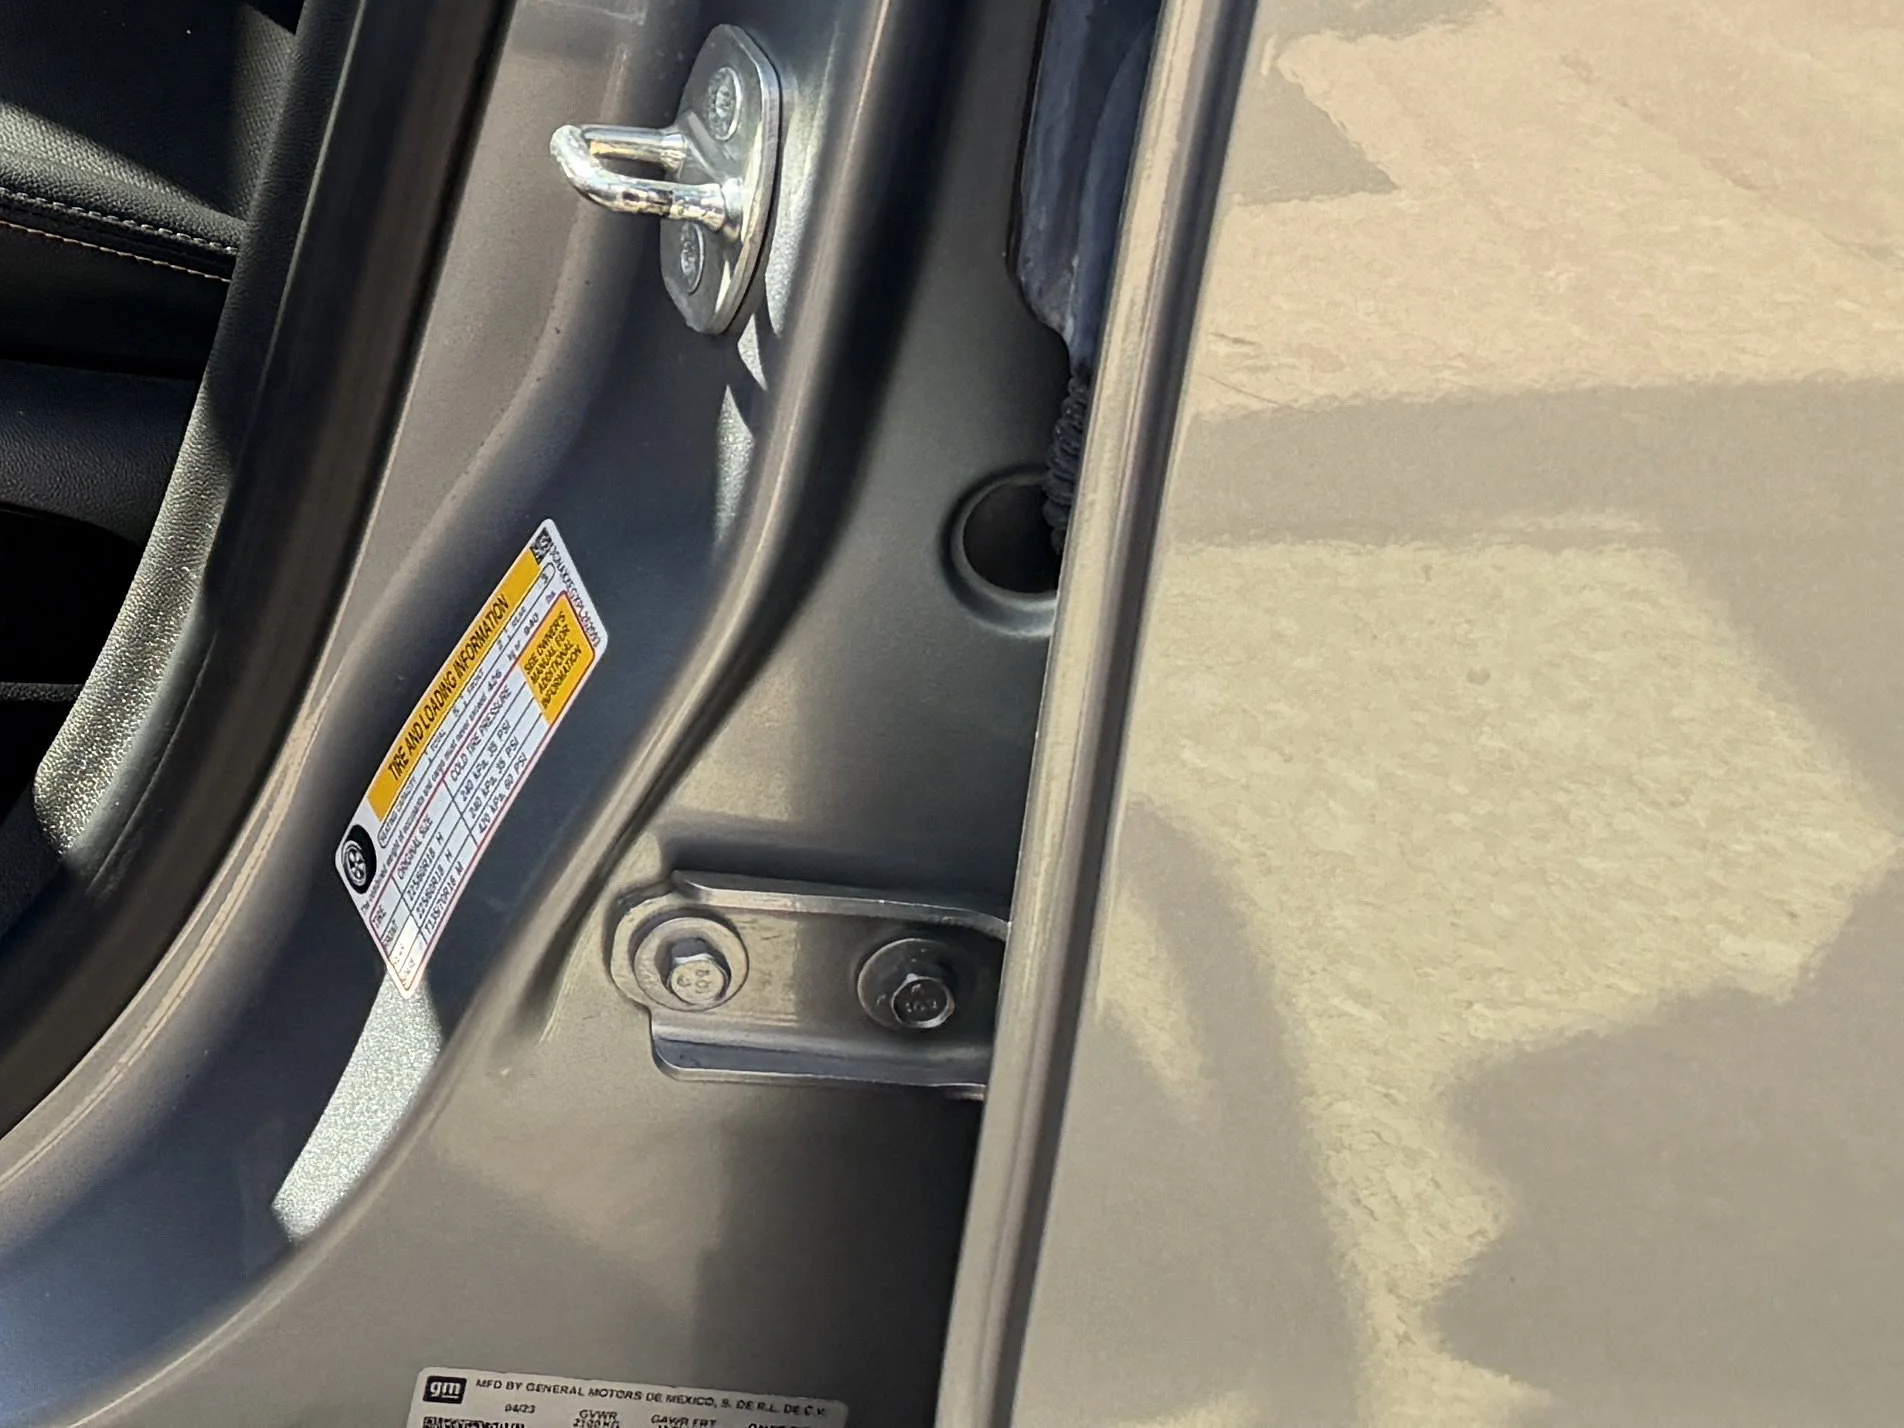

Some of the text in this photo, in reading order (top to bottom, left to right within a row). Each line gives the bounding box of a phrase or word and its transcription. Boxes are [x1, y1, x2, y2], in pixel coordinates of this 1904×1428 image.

[485, 665, 502, 694] 426
[522, 609, 539, 639] 940
[523, 649, 539, 676] SEE
[529, 620, 570, 687] MANUAL FOR
[537, 637, 573, 695] ADDITIONAL
[540, 642, 582, 710] INFORMATION
[387, 592, 509, 783] TIRE AND LOADING INFORMATION
[449, 683, 511, 783] COLD TIRE PRESSURE
[459, 777, 474, 802] 240
[496, 717, 511, 743] PSI
[504, 733, 519, 759] PSI
[513, 749, 527, 775] PSI
[396, 812, 433, 881] ORIGINAL SIZE
[372, 902, 386, 930] TIRE
[430, 1381, 460, 1399] gm
[476, 1379, 502, 1389] MFD
[505, 1381, 523, 1390] BY
[526, 1383, 585, 1396] GENERAL
[588, 1388, 642, 1401] MOTORS
[645, 1392, 662, 1403] DE
[579, 1409, 618, 1420] GVWR
